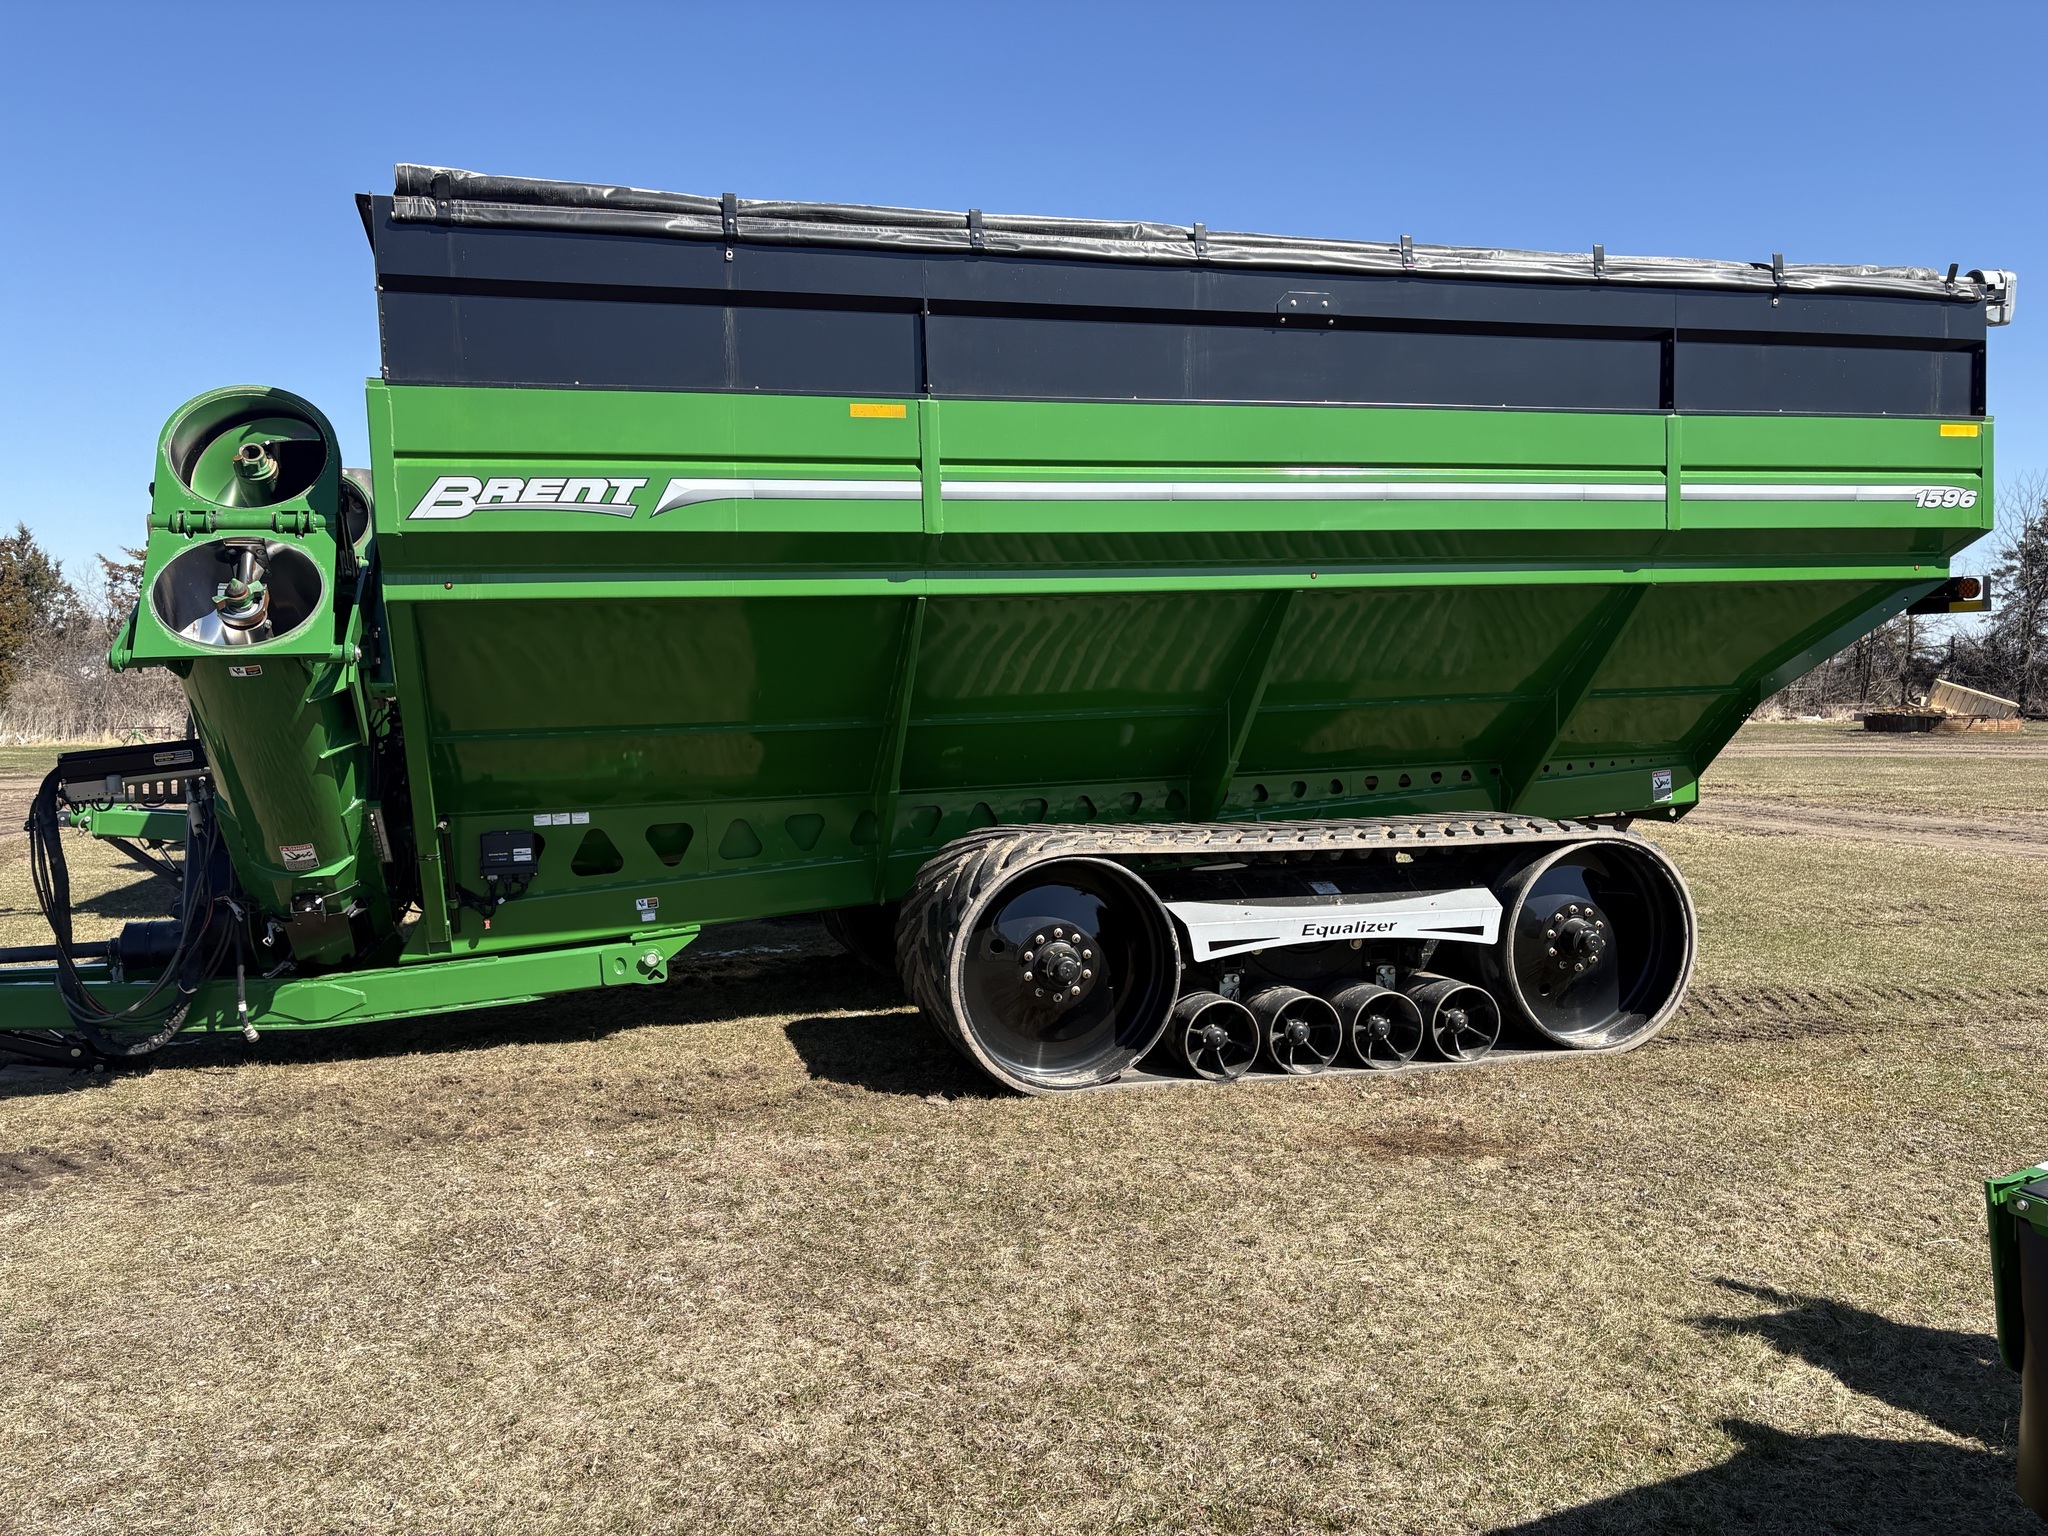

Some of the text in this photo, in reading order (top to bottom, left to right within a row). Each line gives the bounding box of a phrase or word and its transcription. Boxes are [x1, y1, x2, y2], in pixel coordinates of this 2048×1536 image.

[407, 475, 650, 520] BRENT
[1915, 489, 1978, 510] 1596
[1301, 921, 1398, 938] Equalizer
